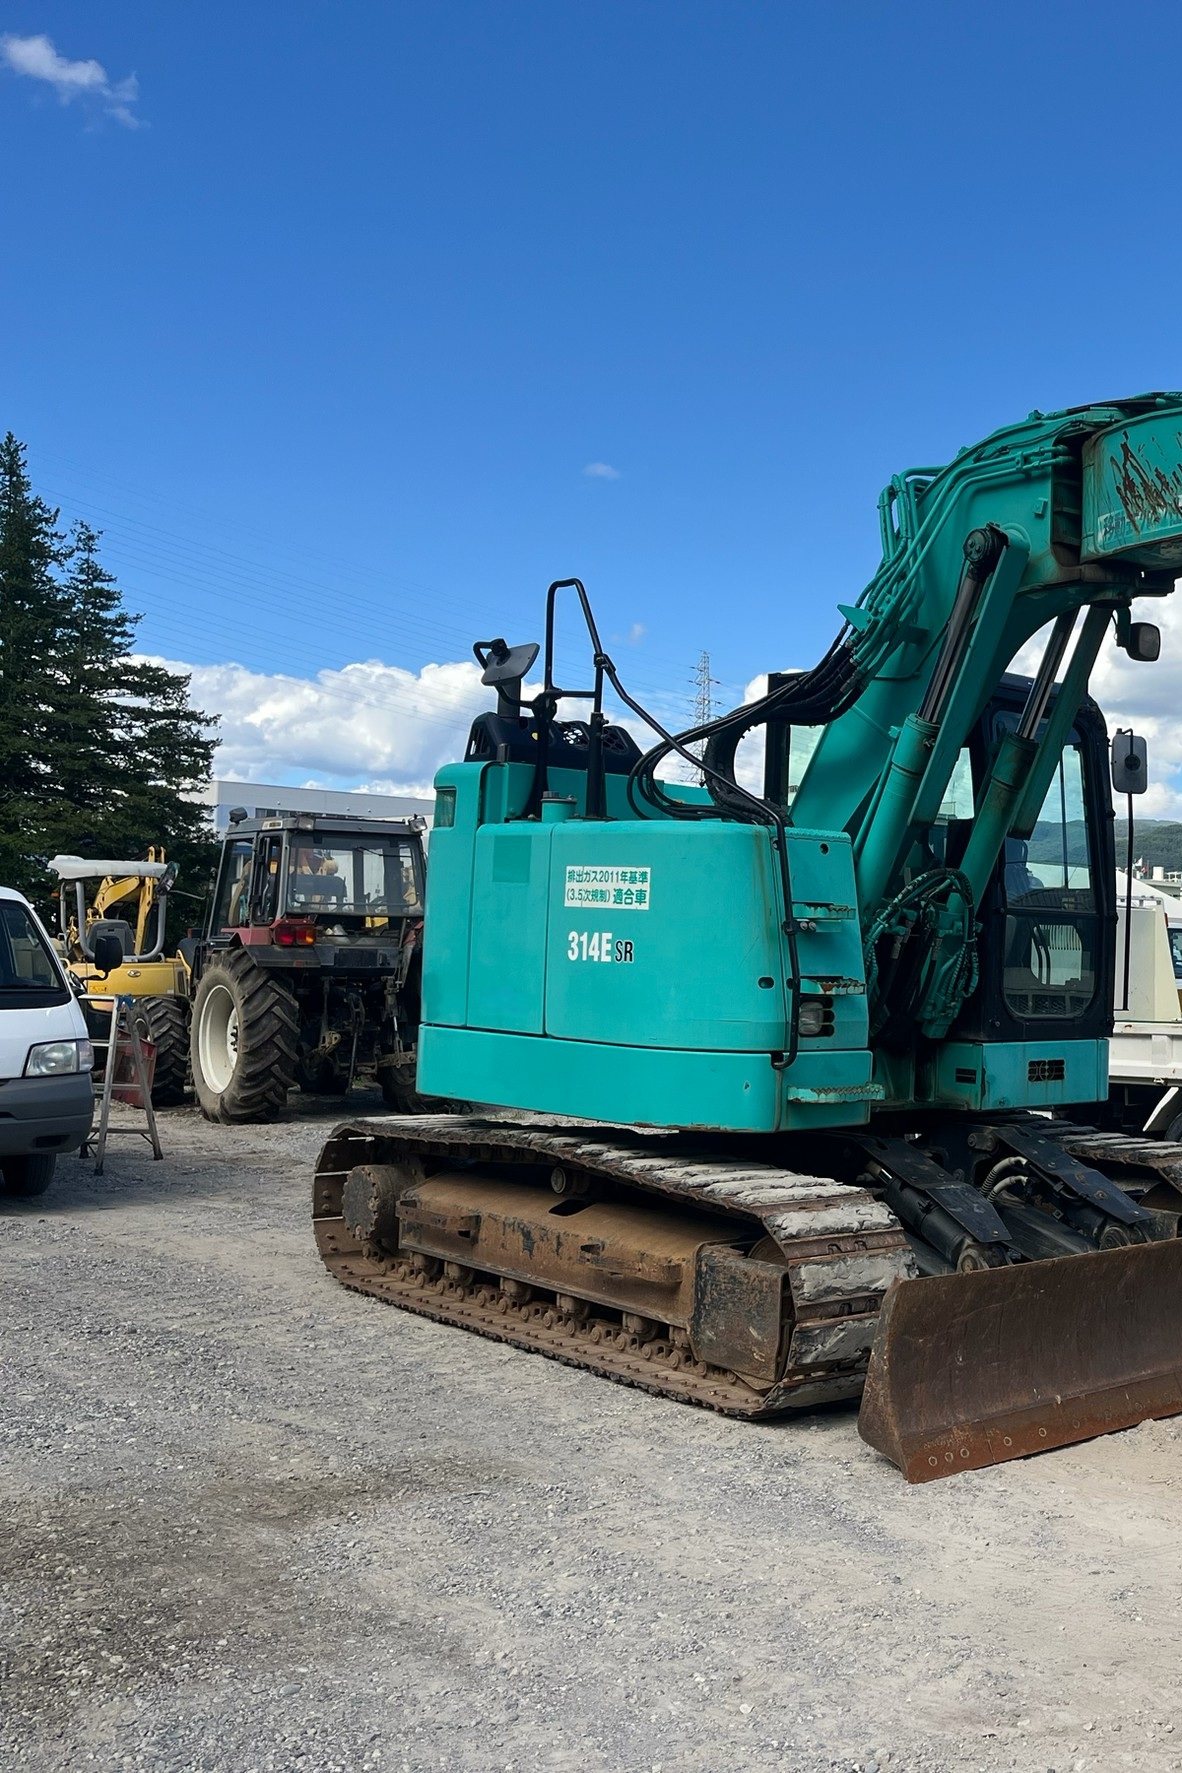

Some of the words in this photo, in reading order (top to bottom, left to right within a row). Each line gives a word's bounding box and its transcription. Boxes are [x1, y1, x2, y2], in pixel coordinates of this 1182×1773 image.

[567, 869, 648, 885] 排出ガス2011年基準
[566, 888, 611, 903] (3.5次規制)
[612, 888, 648, 906] 適合車
[567, 931, 613, 962] 314E
[614, 940, 634, 963] SR
